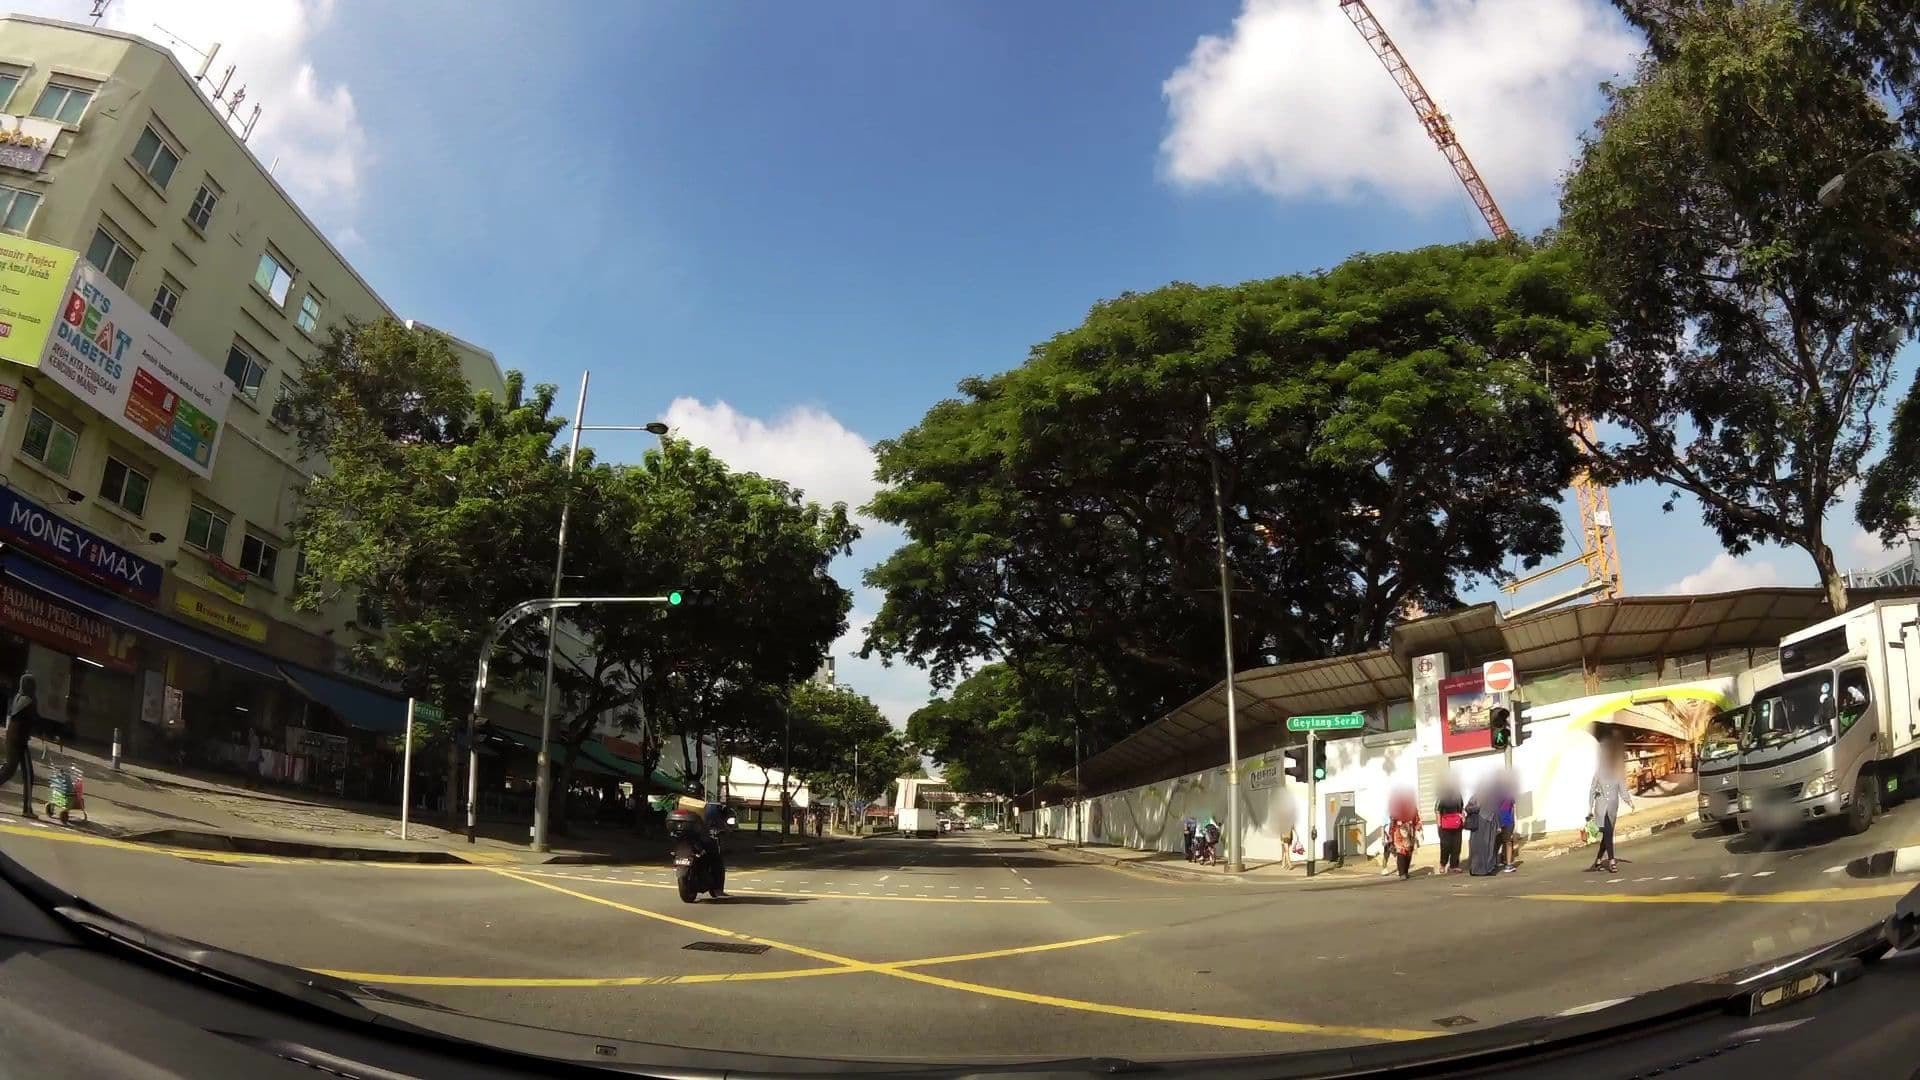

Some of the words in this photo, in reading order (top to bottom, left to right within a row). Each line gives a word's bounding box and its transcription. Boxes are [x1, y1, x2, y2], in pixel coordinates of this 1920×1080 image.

[26, 252, 57, 269] Project
[76, 275, 111, 314] LET'S
[63, 291, 133, 361] BEAT
[57, 322, 122, 380] DIABETES
[10, 501, 90, 558] MONEY
[97, 546, 145, 586] MAX
[1293, 717, 1332, 729] Geylang
[1334, 715, 1359, 726] Serai
